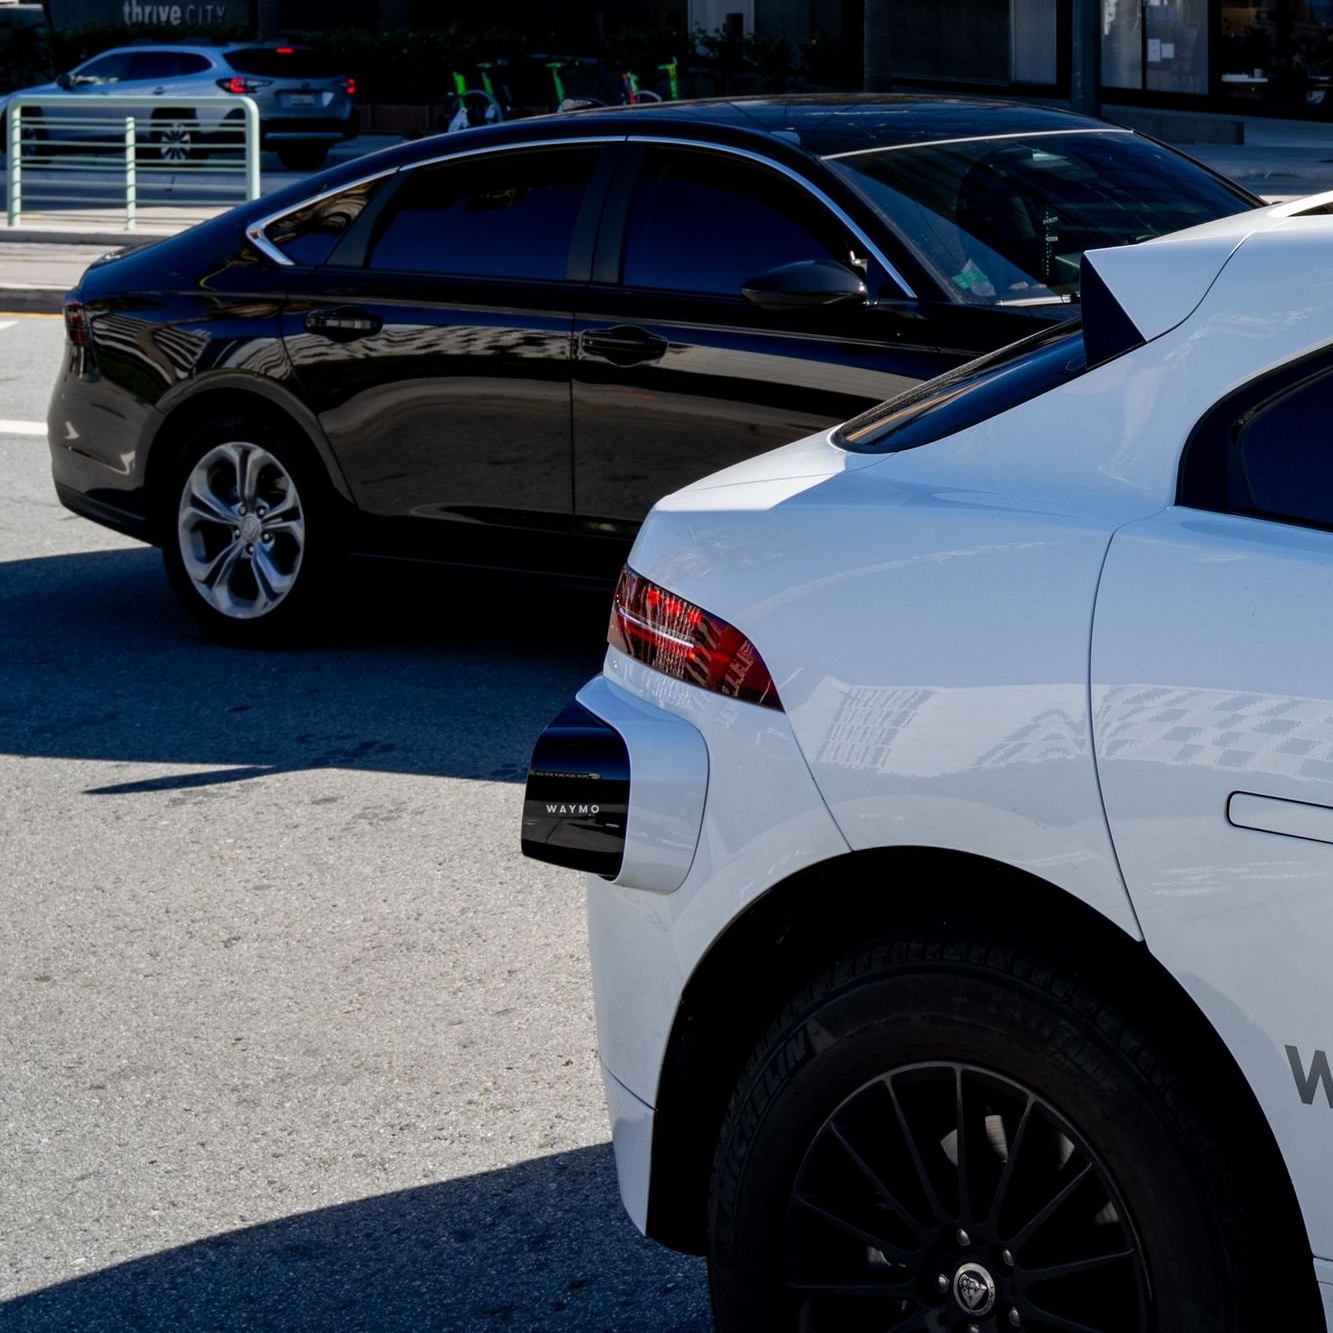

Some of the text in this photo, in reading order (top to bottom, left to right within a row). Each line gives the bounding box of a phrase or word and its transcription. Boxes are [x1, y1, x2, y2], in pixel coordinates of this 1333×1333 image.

[185, 4, 226, 25] CITY
[546, 804, 600, 814] WAYMO
[717, 1026, 809, 1214] MICHELIN
